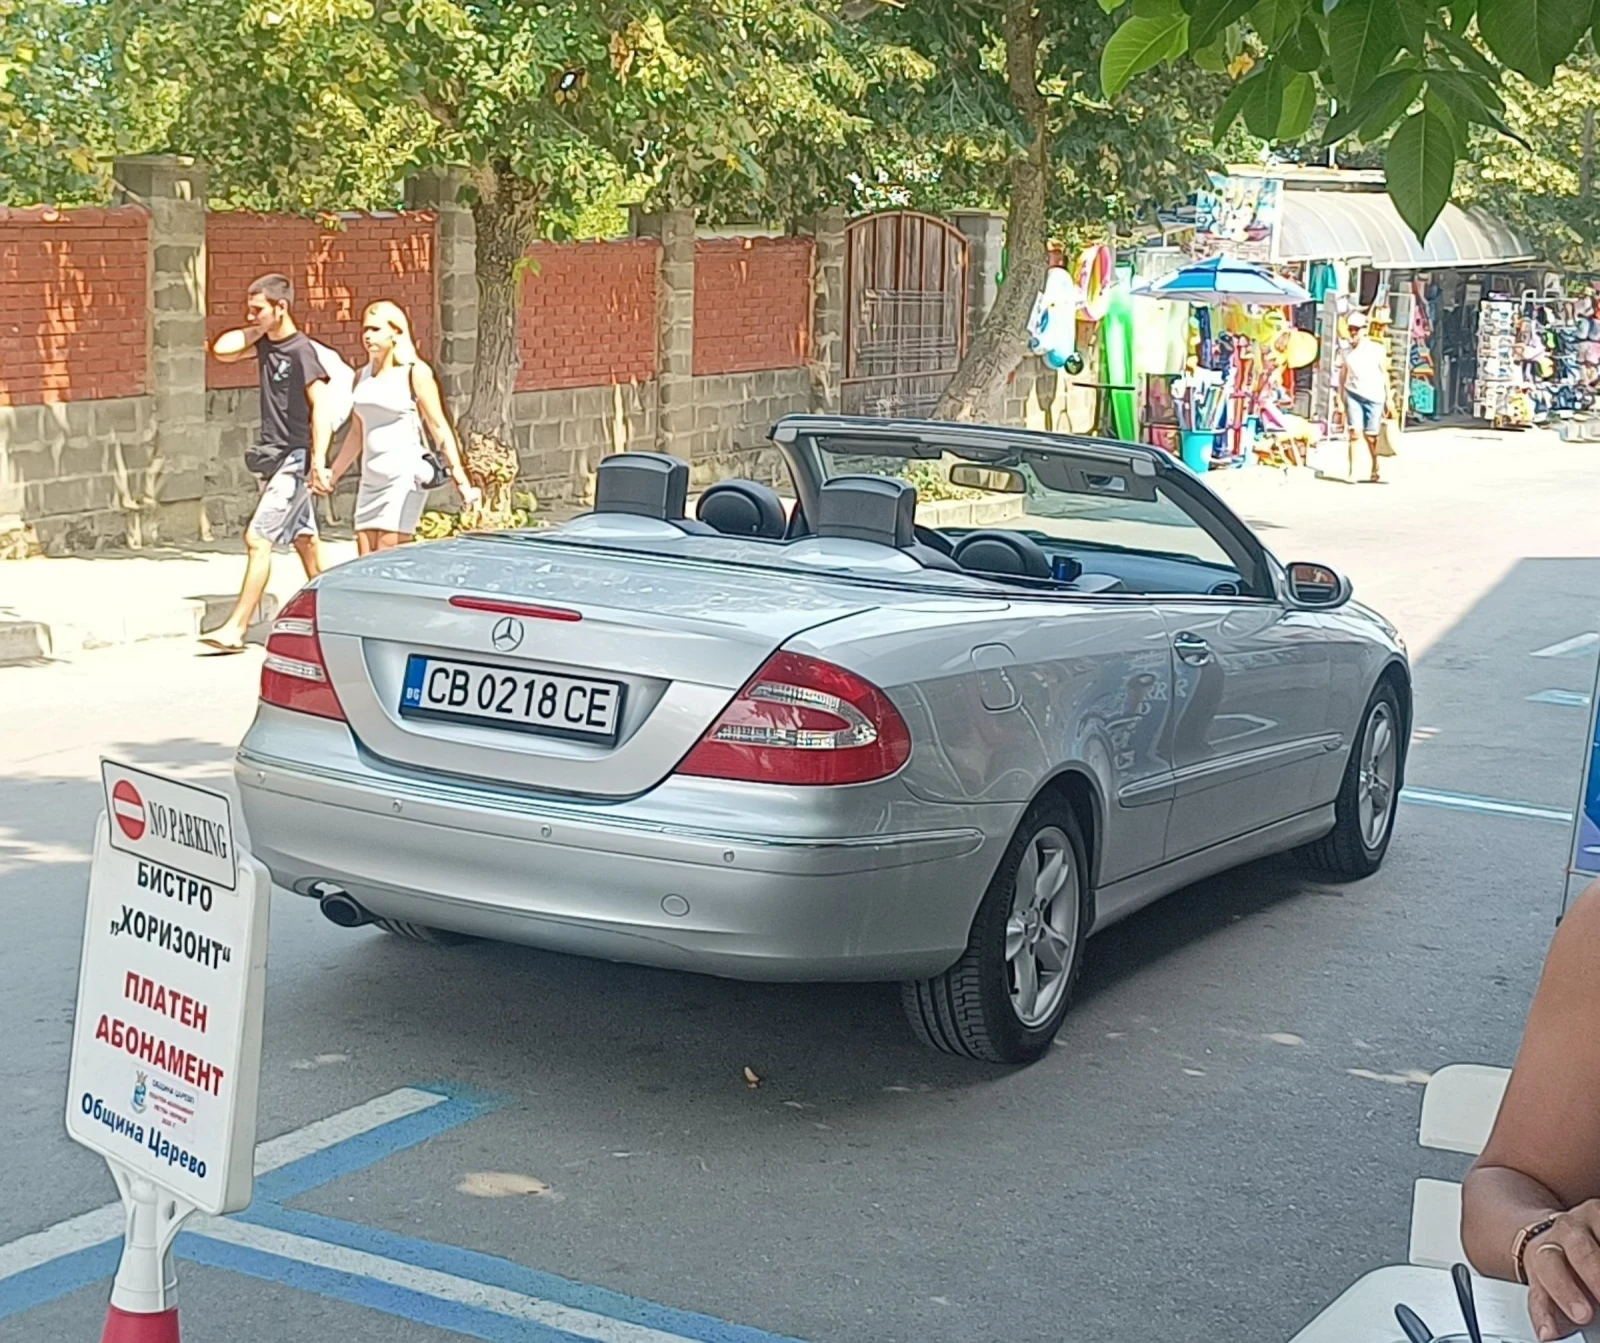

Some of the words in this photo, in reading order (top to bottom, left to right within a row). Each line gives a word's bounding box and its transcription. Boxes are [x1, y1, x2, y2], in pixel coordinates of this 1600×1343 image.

[406, 687, 420, 700] BG
[427, 667, 471, 707] CB
[477, 673, 558, 719] 0218
[564, 686, 611, 727] CE
[148, 801, 168, 839] NO
[169, 807, 227, 859] PARKING
[137, 861, 213, 912] БИСТРО
[124, 971, 208, 1033] ПЛАТЕН
[95, 1014, 224, 1097] АБОНАМЕНТ
[81, 1092, 144, 1144] Община
[147, 1127, 207, 1179] Царево
